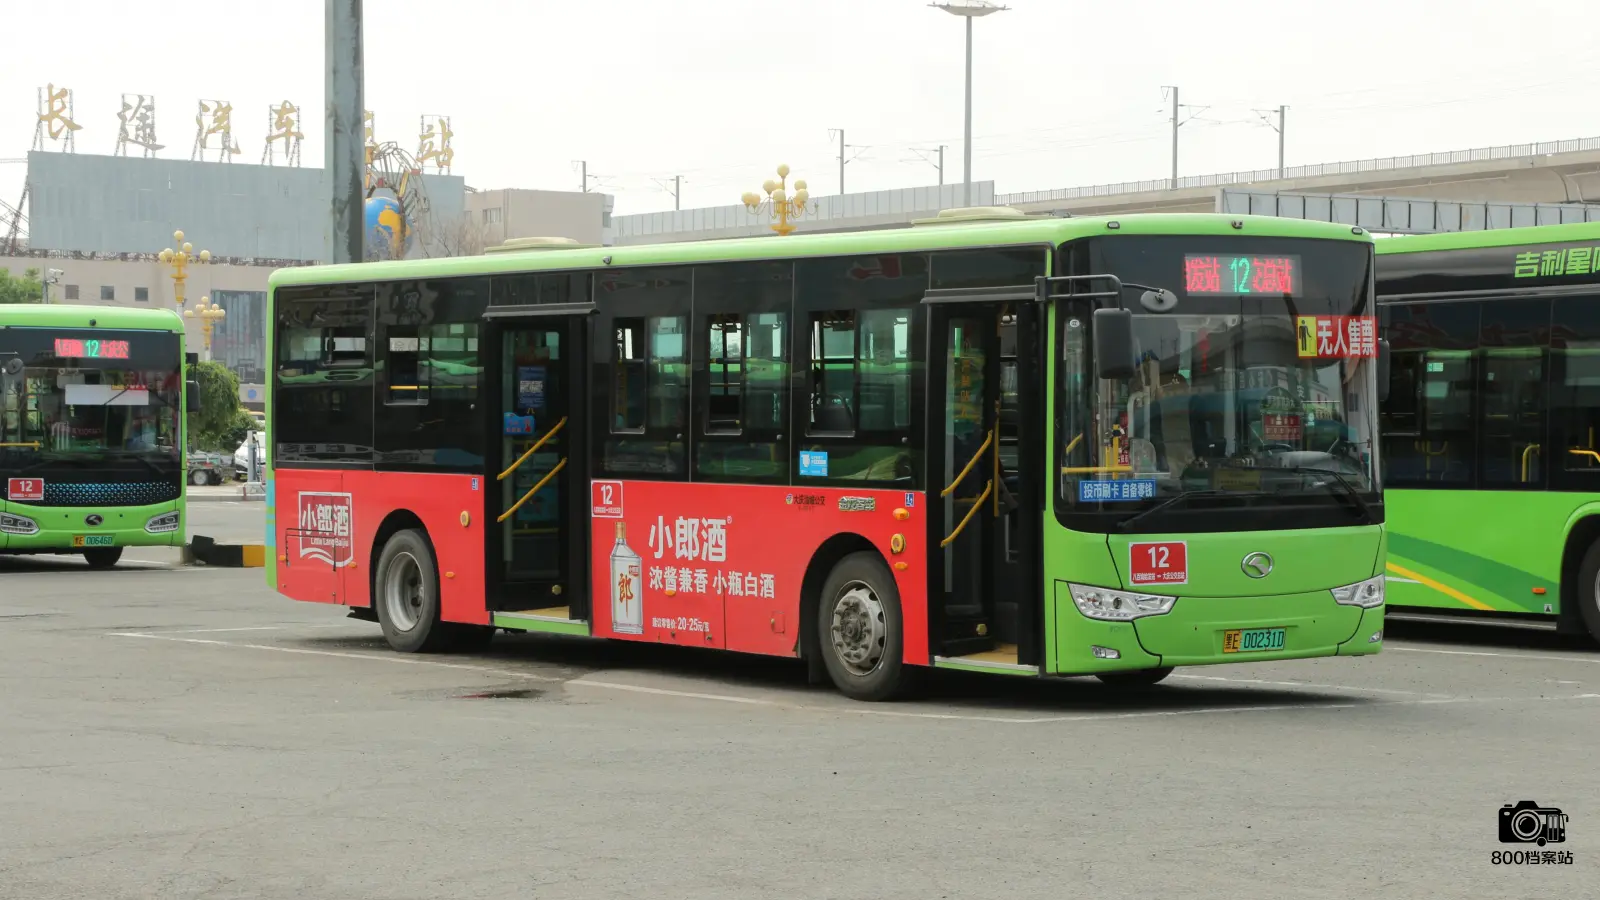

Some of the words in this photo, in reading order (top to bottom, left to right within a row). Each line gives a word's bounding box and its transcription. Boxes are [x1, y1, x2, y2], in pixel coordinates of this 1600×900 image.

[38, 83, 454, 167] 长途汽车站
[1230, 257, 1250, 293] 12
[85, 339, 99, 357] 12
[1316, 318, 1376, 357] 无人售票
[19, 480, 33, 492] 12
[600, 484, 613, 505] 12
[1083, 482, 1119, 499] 投币刷卡
[1122, 482, 1153, 498] 自备零钱
[302, 503, 348, 536] 小郎酒
[648, 515, 728, 562] 小郎酒
[1147, 546, 1170, 568] 12
[618, 572, 634, 618] 郎
[649, 566, 709, 594] 浓酱兼香
[712, 570, 775, 599] 小瓶白酒
